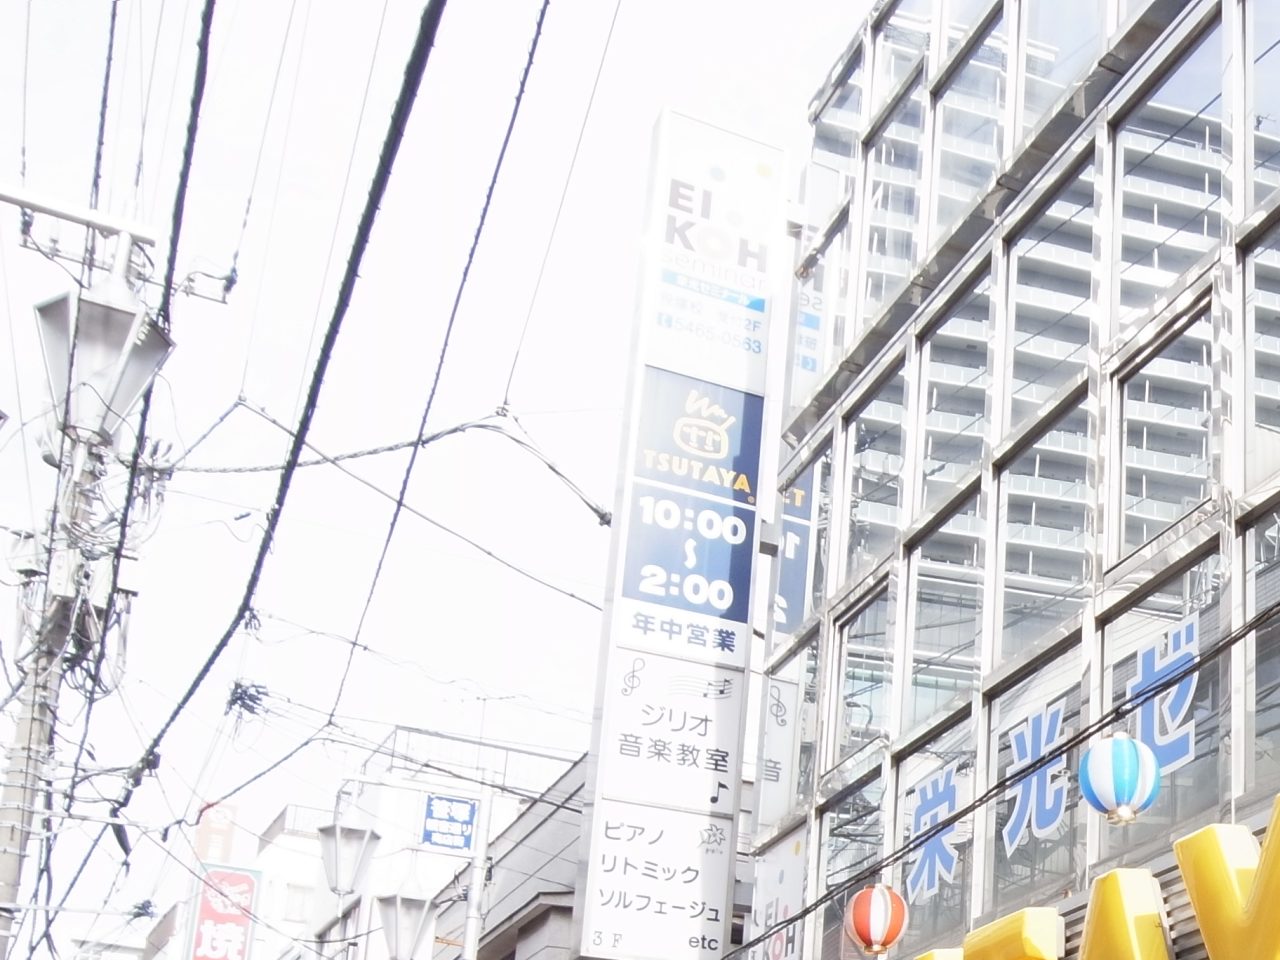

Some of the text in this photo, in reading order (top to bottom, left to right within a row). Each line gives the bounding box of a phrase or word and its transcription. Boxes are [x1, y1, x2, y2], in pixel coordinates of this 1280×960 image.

[643, 449, 751, 493] TSUTAYA
[639, 496, 747, 545] 10:00
[638, 564, 734, 611] 2:00
[632, 611, 736, 653] 年中営業
[640, 703, 713, 737] ジリオ
[618, 732, 730, 774] 音楽教室
[604, 820, 665, 847] ピアノ
[601, 853, 701, 885] リトミック
[598, 887, 721, 924] ソルフェージュ
[688, 933, 720, 952] etc
